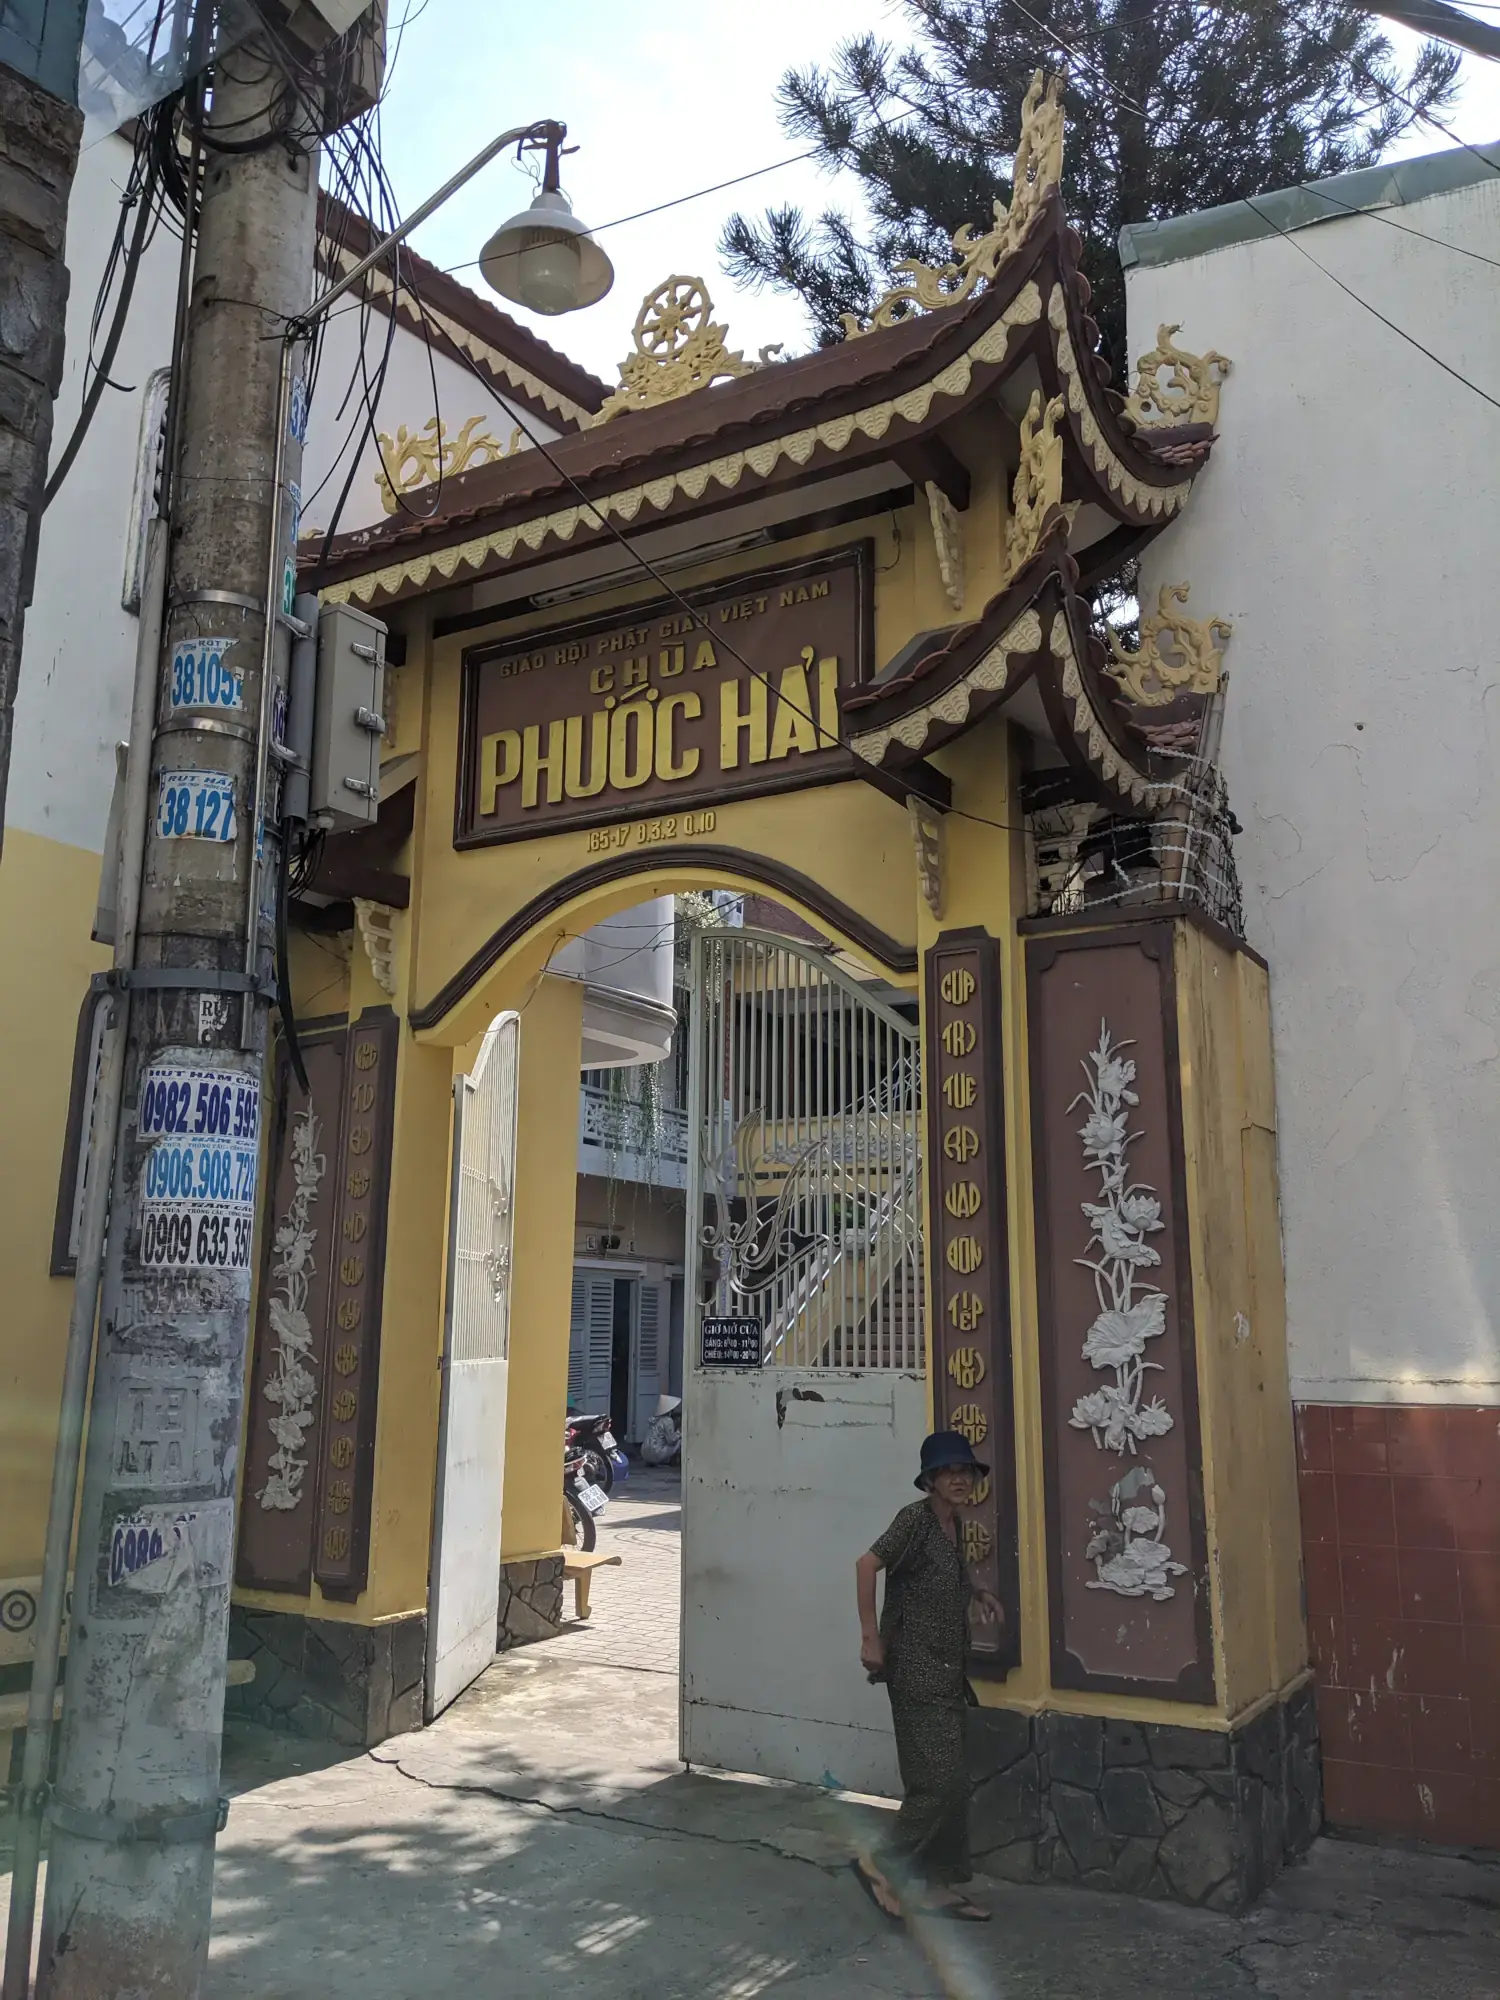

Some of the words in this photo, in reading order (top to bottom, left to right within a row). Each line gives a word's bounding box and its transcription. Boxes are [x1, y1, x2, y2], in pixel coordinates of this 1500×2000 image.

[500, 653, 545, 678] GIÁO
[555, 640, 588, 666] HỘI
[599, 627, 648, 656] PHẬT
[659, 611, 710, 640] GIÁO
[720, 597, 767, 624] VIỆT
[779, 580, 829, 608] NAM
[590, 639, 717, 695] CHÙA
[480, 684, 702, 816] PHƯỚC
[720, 645, 840, 771] HẢI
[683, 811, 717, 836] Q.10
[143, 1080, 258, 1138] 0982.506.595
[943, 1123, 980, 1164] RA
[146, 1147, 256, 1202] 0906.908.728
[144, 1213, 252, 1268] 0909.635.350
[704, 1323, 722, 1335] GIỜ
[722, 1322, 738, 1335] MỞ
[739, 1322, 759, 1335] CỬA
